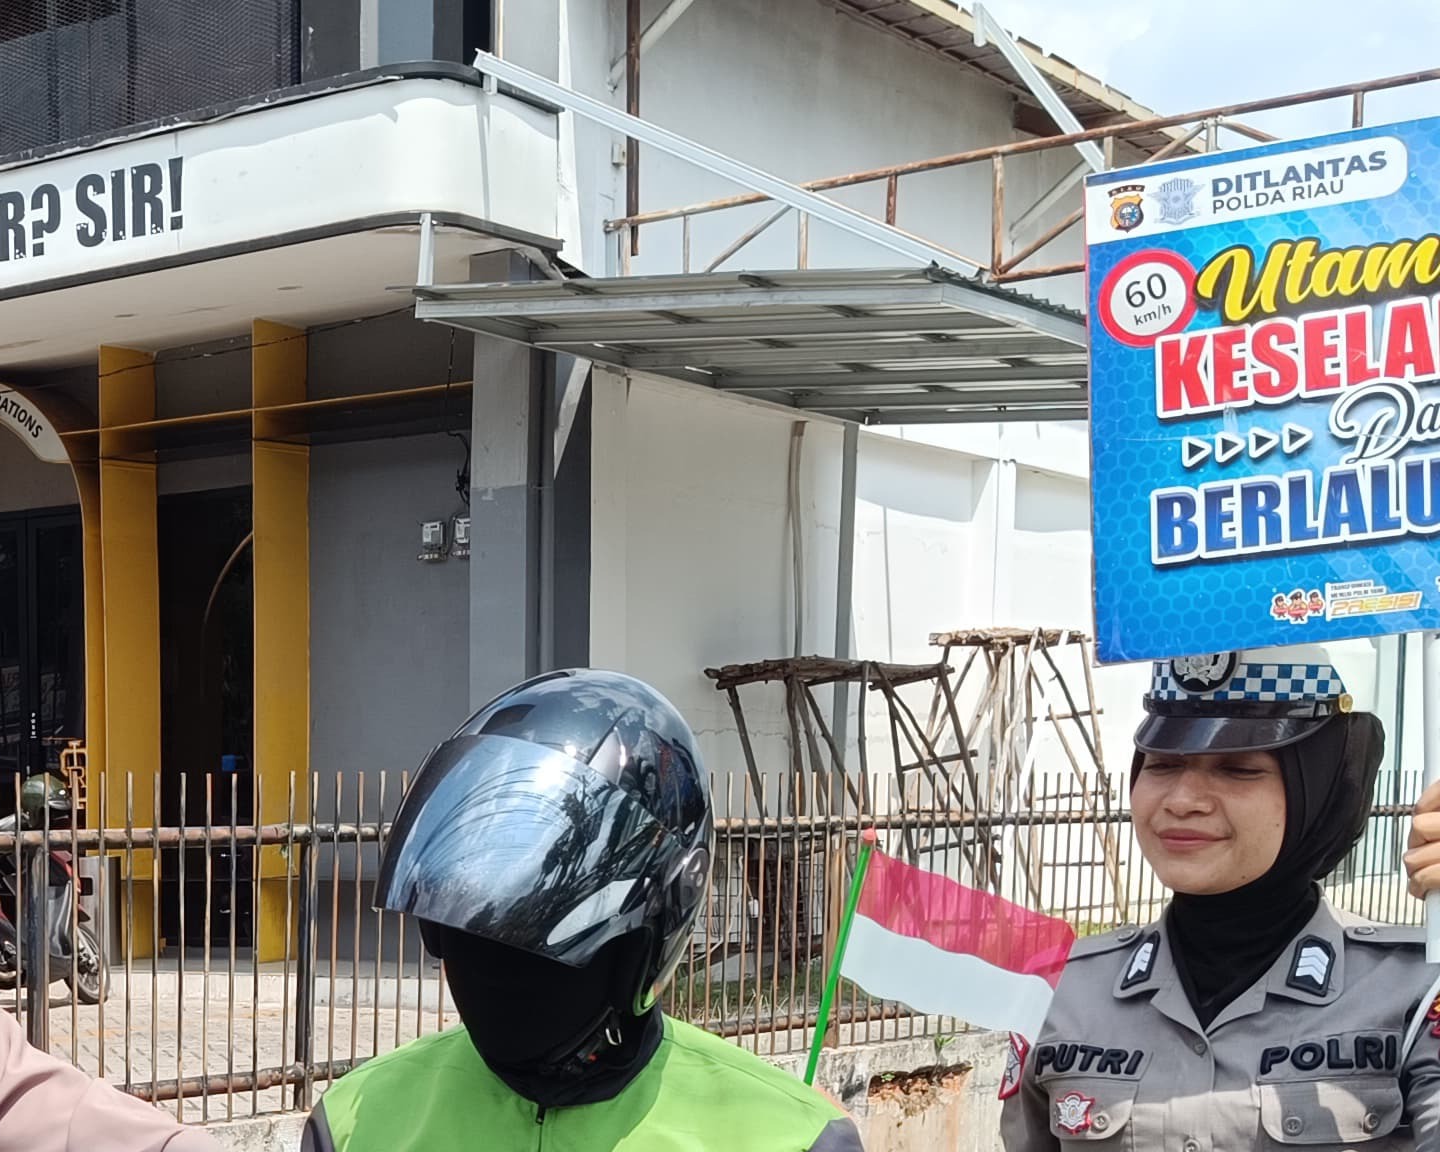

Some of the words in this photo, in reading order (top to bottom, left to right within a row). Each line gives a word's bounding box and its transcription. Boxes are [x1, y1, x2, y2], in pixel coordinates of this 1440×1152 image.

[1211, 150, 1388, 198] DITLANTAS
[74, 156, 184, 247] SIR!
[1212, 190, 1285, 214] POLDA
[1292, 179, 1344, 201] RIAU
[1125, 272, 1168, 309] 60
[1196, 236, 1440, 323] Utam
[1133, 302, 1172, 327] km/h
[1159, 299, 1440, 414] KESELA
[1157, 458, 1440, 557] BERLALU
[1035, 1044, 1144, 1075] PUTRI
[1260, 1035, 1398, 1075] POLRI
